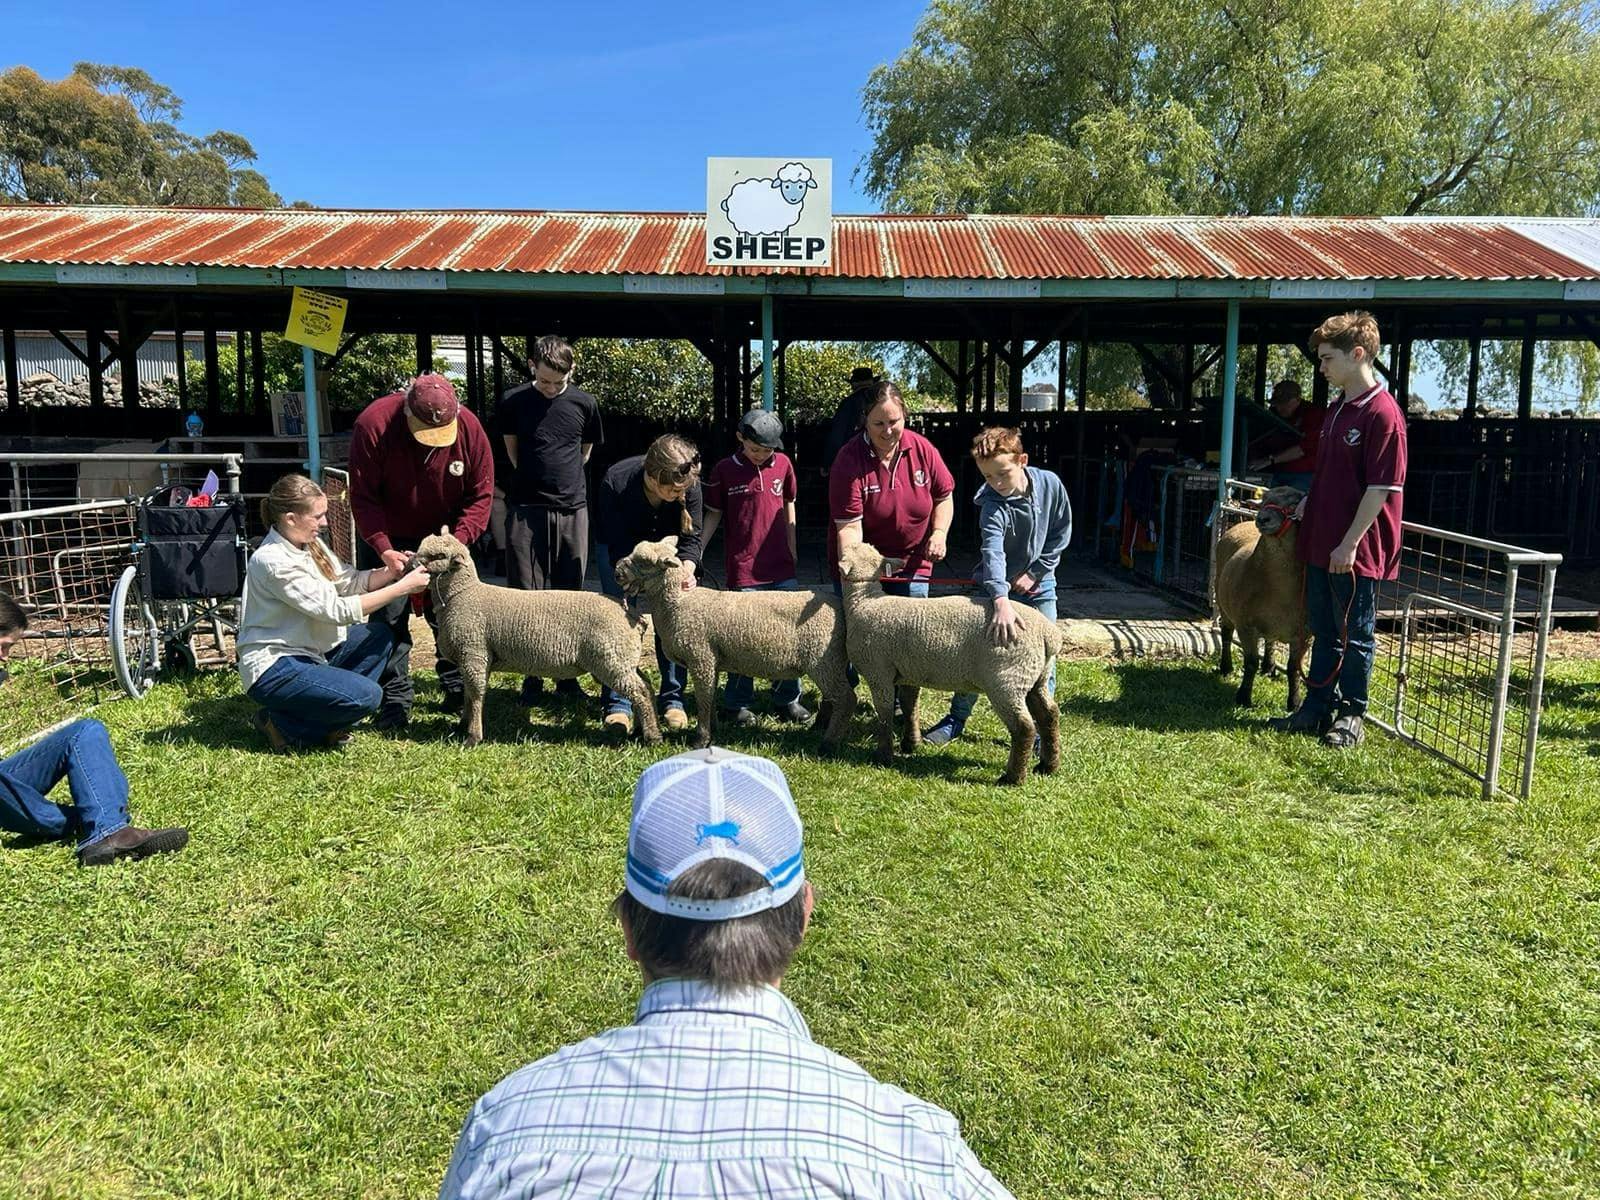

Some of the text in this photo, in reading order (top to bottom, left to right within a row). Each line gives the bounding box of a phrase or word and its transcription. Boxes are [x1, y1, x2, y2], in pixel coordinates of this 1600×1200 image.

[712, 236, 826, 261] SHEEP
[355, 271, 434, 287] ROMNEY
[910, 279, 1035, 296] AUSSIE WHITE
